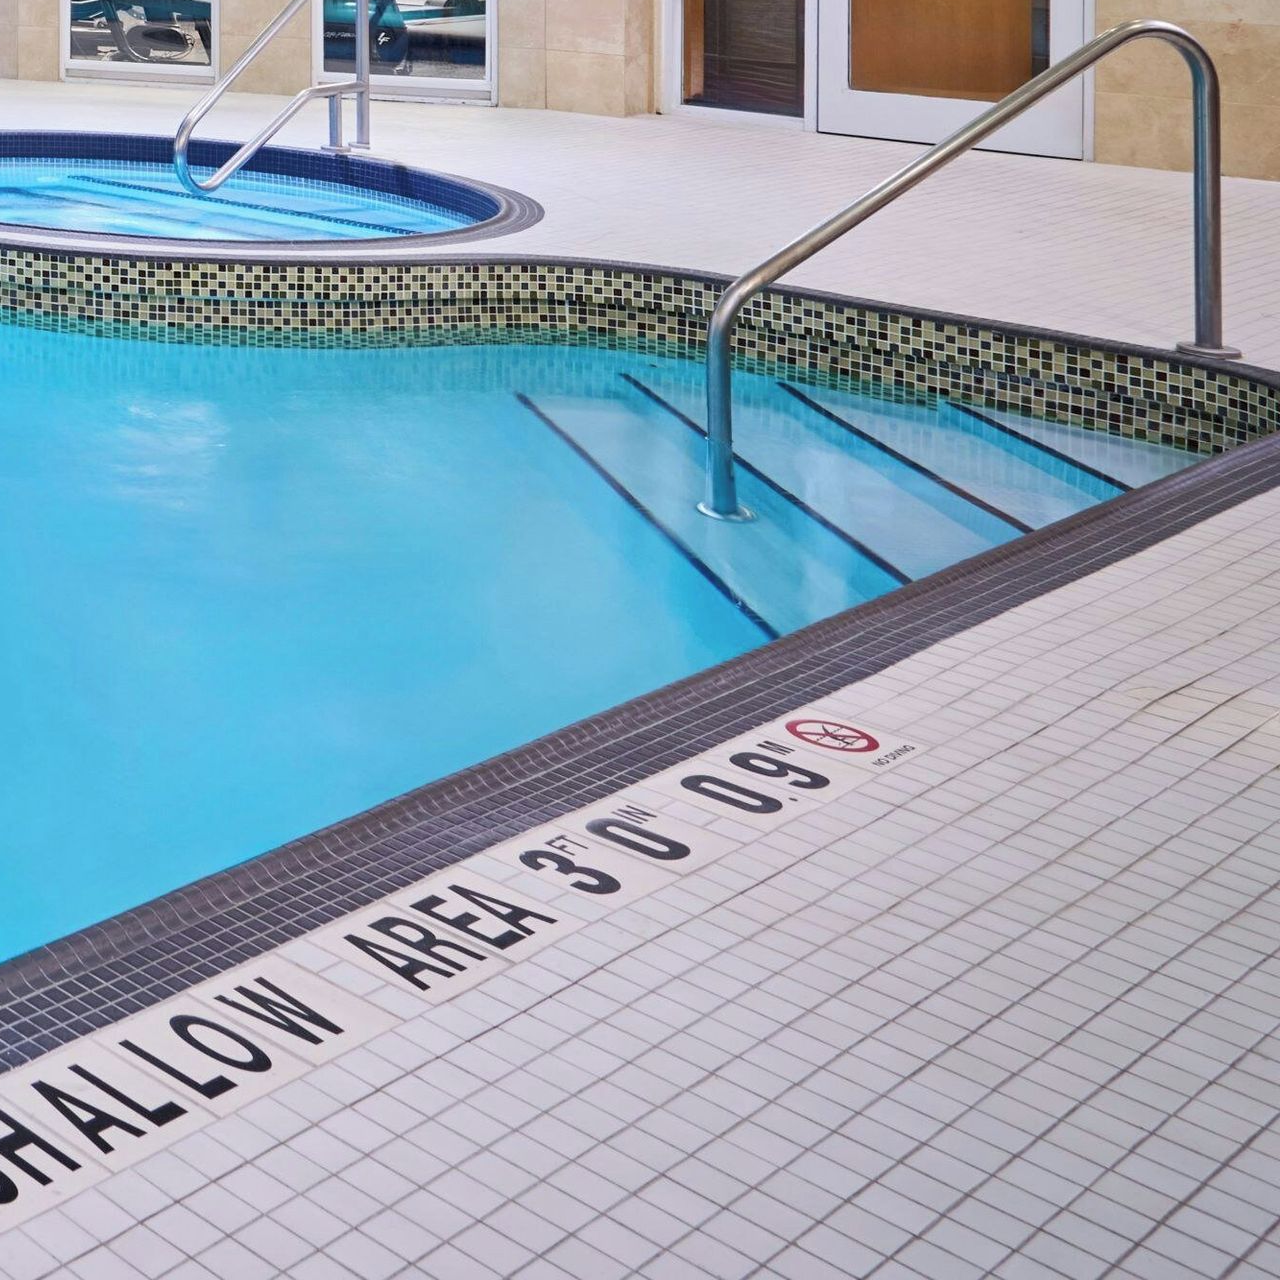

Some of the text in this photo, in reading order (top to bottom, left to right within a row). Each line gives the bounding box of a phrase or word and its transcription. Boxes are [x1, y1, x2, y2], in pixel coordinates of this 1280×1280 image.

[872, 745, 915, 767] NO DIVING
[343, 884, 559, 991] AREA
